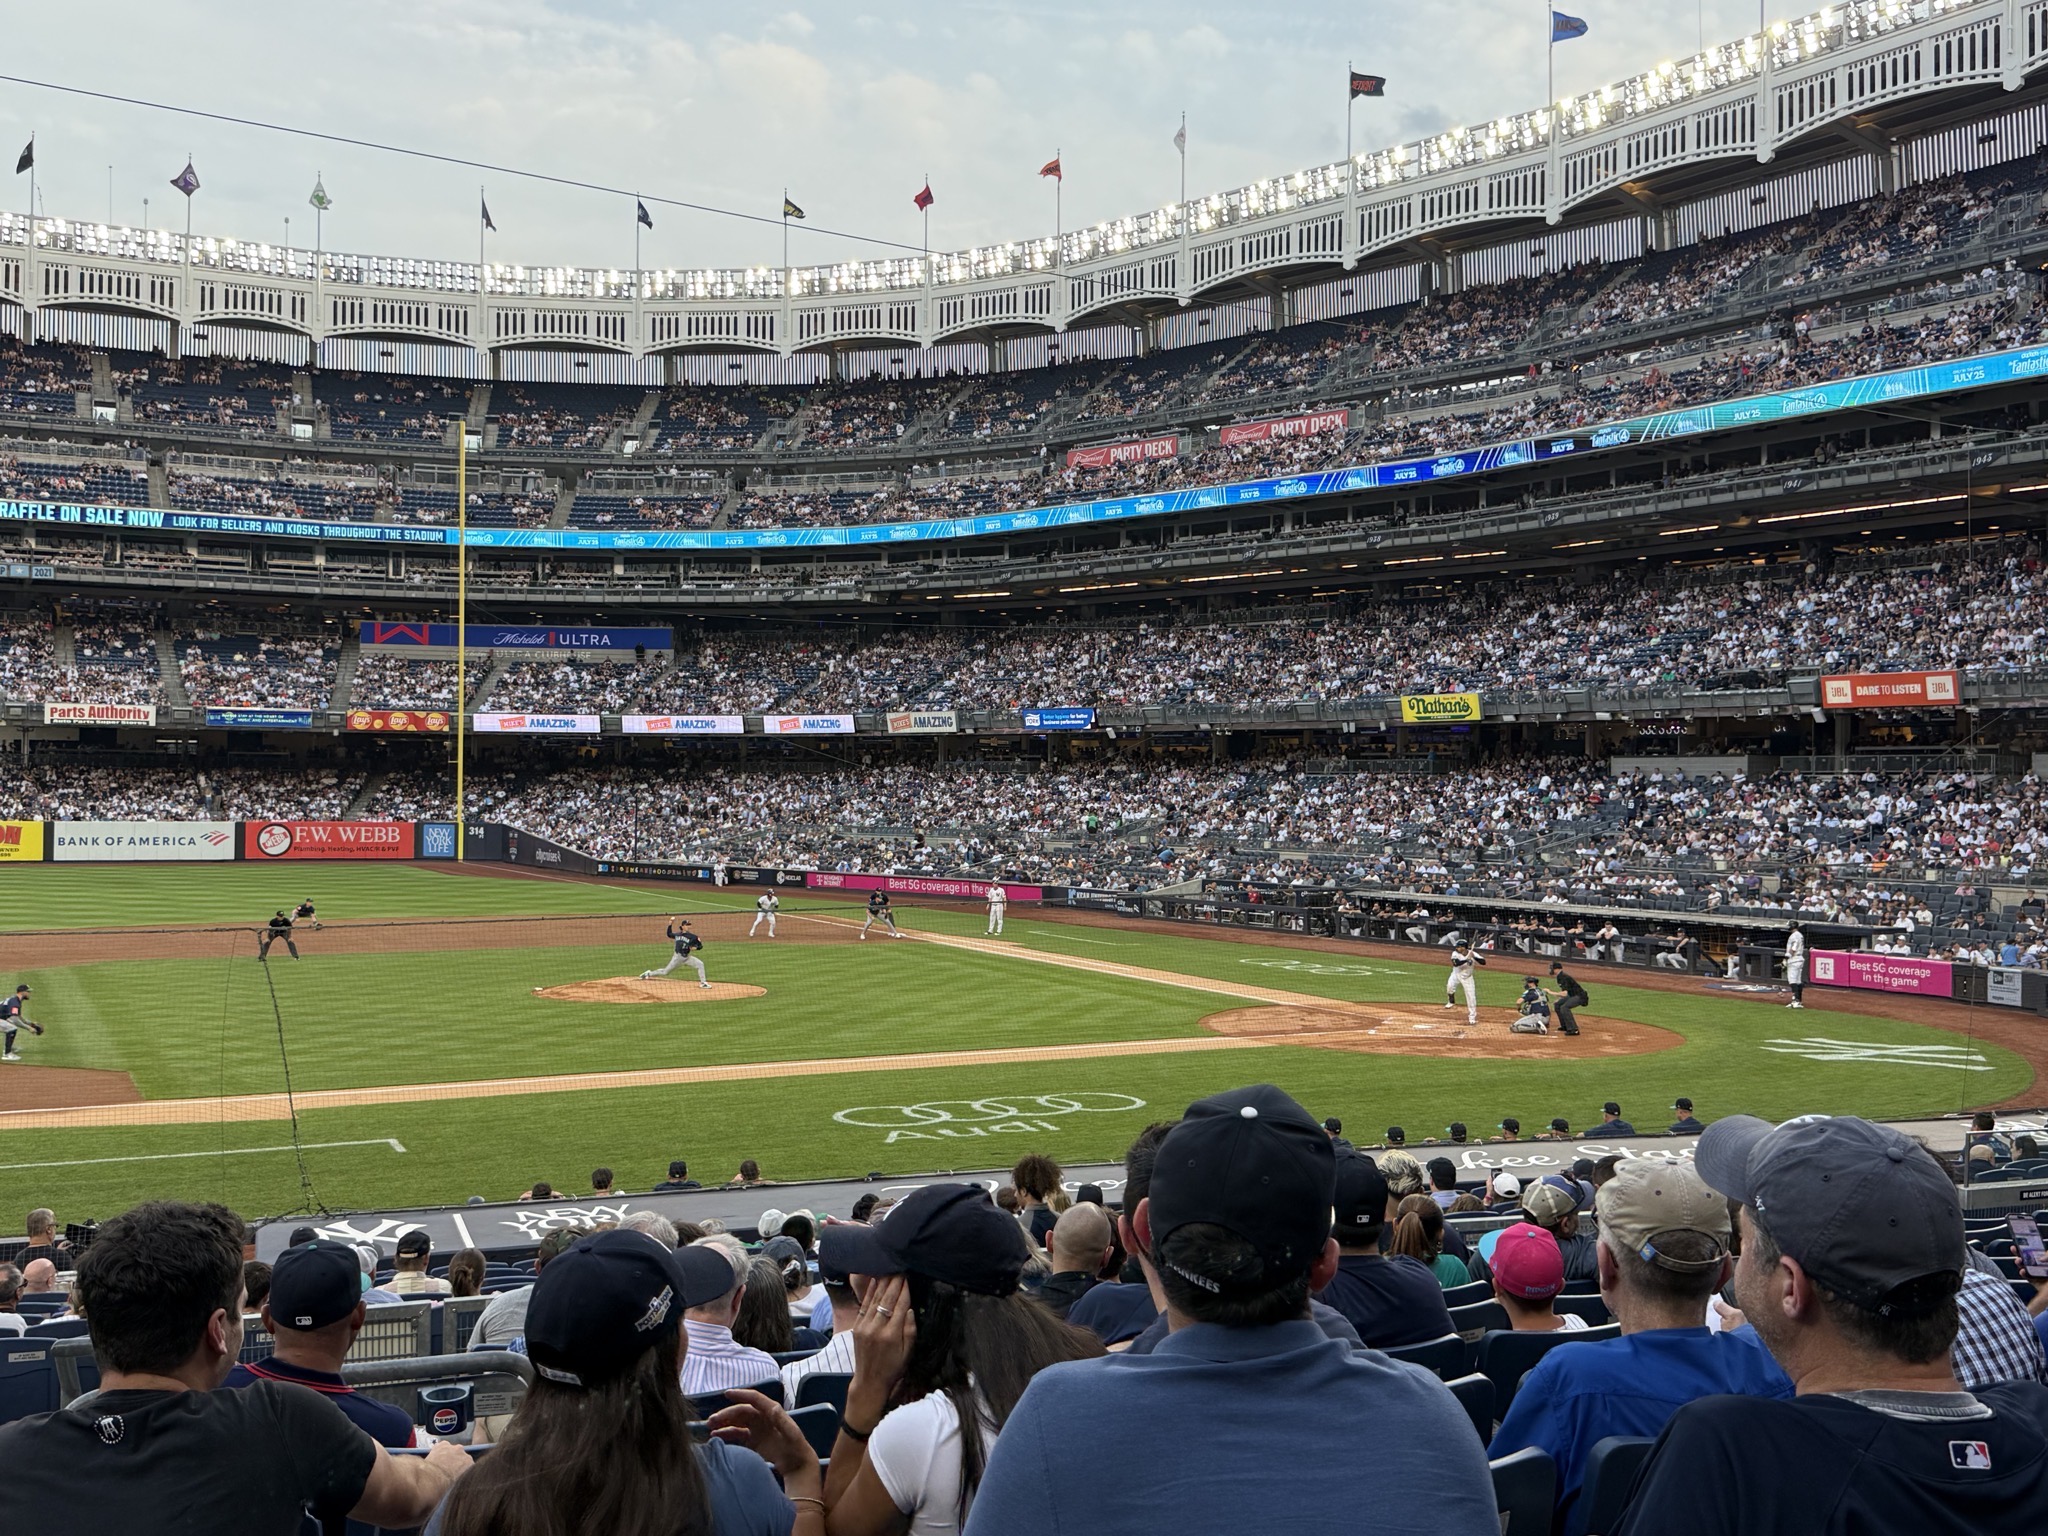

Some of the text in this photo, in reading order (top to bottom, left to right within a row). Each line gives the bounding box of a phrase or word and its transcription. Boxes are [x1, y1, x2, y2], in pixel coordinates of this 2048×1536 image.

[1952, 370, 1985, 384] JULY 25
[1733, 409, 1760, 421] JULY 25
[1271, 413, 1344, 437] PARTY DECK
[1110, 439, 1173, 463] PARTY DECK
[1551, 443, 1575, 454] JULY 25
[1394, 469, 1417, 480] JULY 25
[1240, 490, 1260, 499] JULY 25
[0, 502, 164, 527] RAFFLE ON SALE NOW
[173, 516, 443, 542] LOOK FOR SELLERS AND KIOSKS THROUGHOUT THE STADIUM
[34, 568, 52, 577] 2021
[493, 632, 611, 646] Michelob ULTRA
[1832, 687, 1847, 697] JBL
[1857, 684, 1921, 696] DARE TO LISTEN
[1932, 683, 1949, 693] JBL
[1408, 697, 1470, 714] Nathan's
[50, 705, 150, 720] Parts Authority
[529, 718, 576, 728] AMAZING
[675, 720, 716, 729] AMAZING
[803, 719, 841, 729] AMAZING
[913, 716, 953, 728] AMAZING
[295, 826, 400, 843] F.W. WEBB
[429, 828, 450, 837] NEW
[469, 827, 484, 835] 314
[58, 836, 197, 846] BANK OF AMERICA
[426, 835, 452, 845] YORK
[429, 844, 449, 853] LIFE
[889, 879, 907, 889] Best
[908, 880, 920, 890] 5G
[921, 882, 960, 895] coverage
[961, 883, 970, 893] in
[972, 883, 984, 894] the
[1850, 960, 1931, 978] Best 5G coverage
[1863, 973, 1919, 987] in the game
